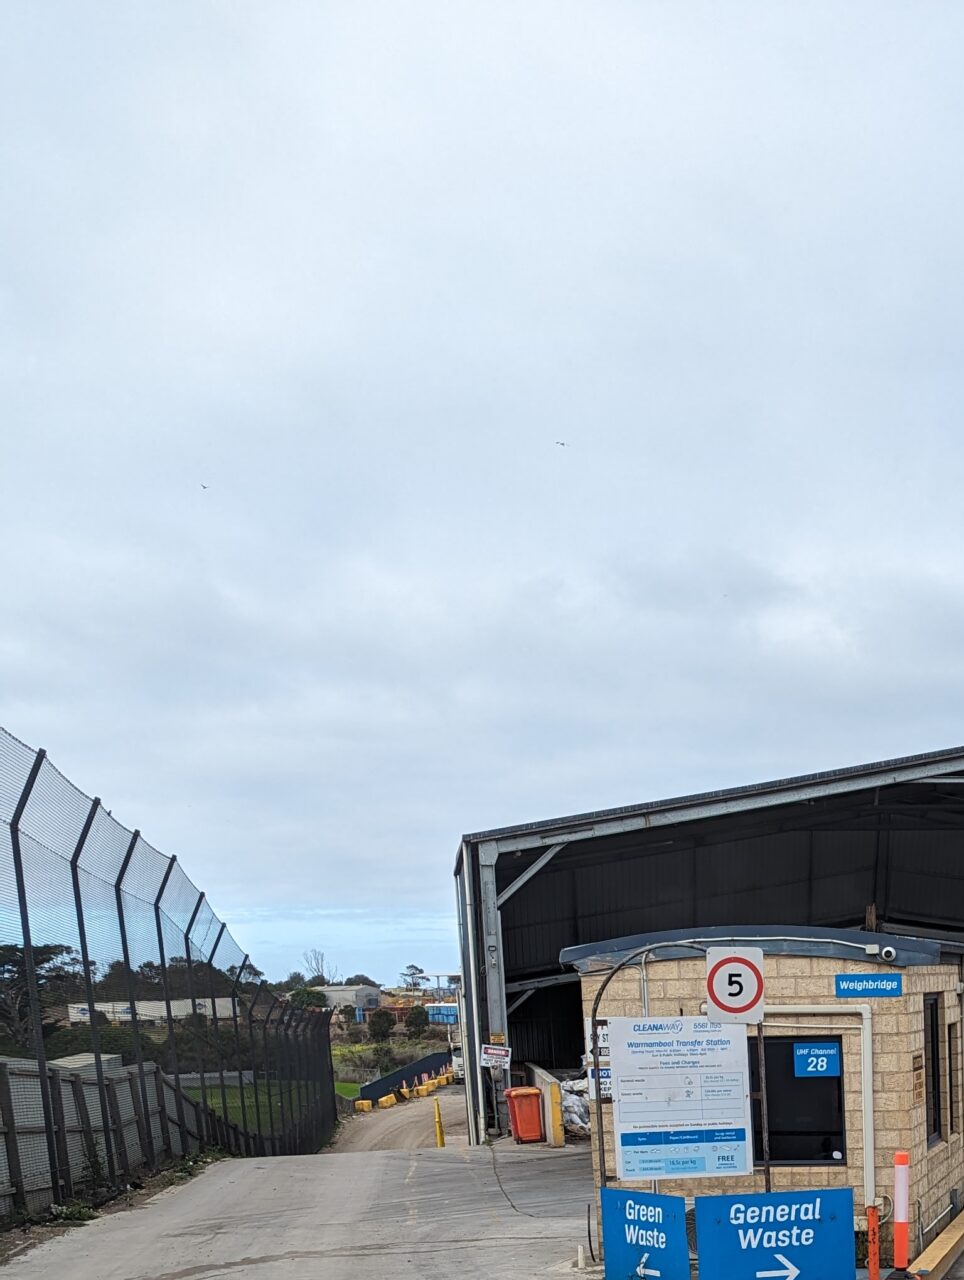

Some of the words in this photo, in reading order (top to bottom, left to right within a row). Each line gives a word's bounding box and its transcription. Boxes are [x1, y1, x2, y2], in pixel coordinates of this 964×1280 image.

[727, 973, 744, 997] 5
[839, 980, 898, 991] Weighbridge
[633, 1021, 681, 1032] CLEANAWAY
[676, 1039, 704, 1048] Transfer
[807, 1057, 827, 1072] 28
[625, 1200, 662, 1223] Green
[729, 1198, 821, 1225] General
[624, 1224, 666, 1248] Waste
[738, 1225, 815, 1249] Waste
